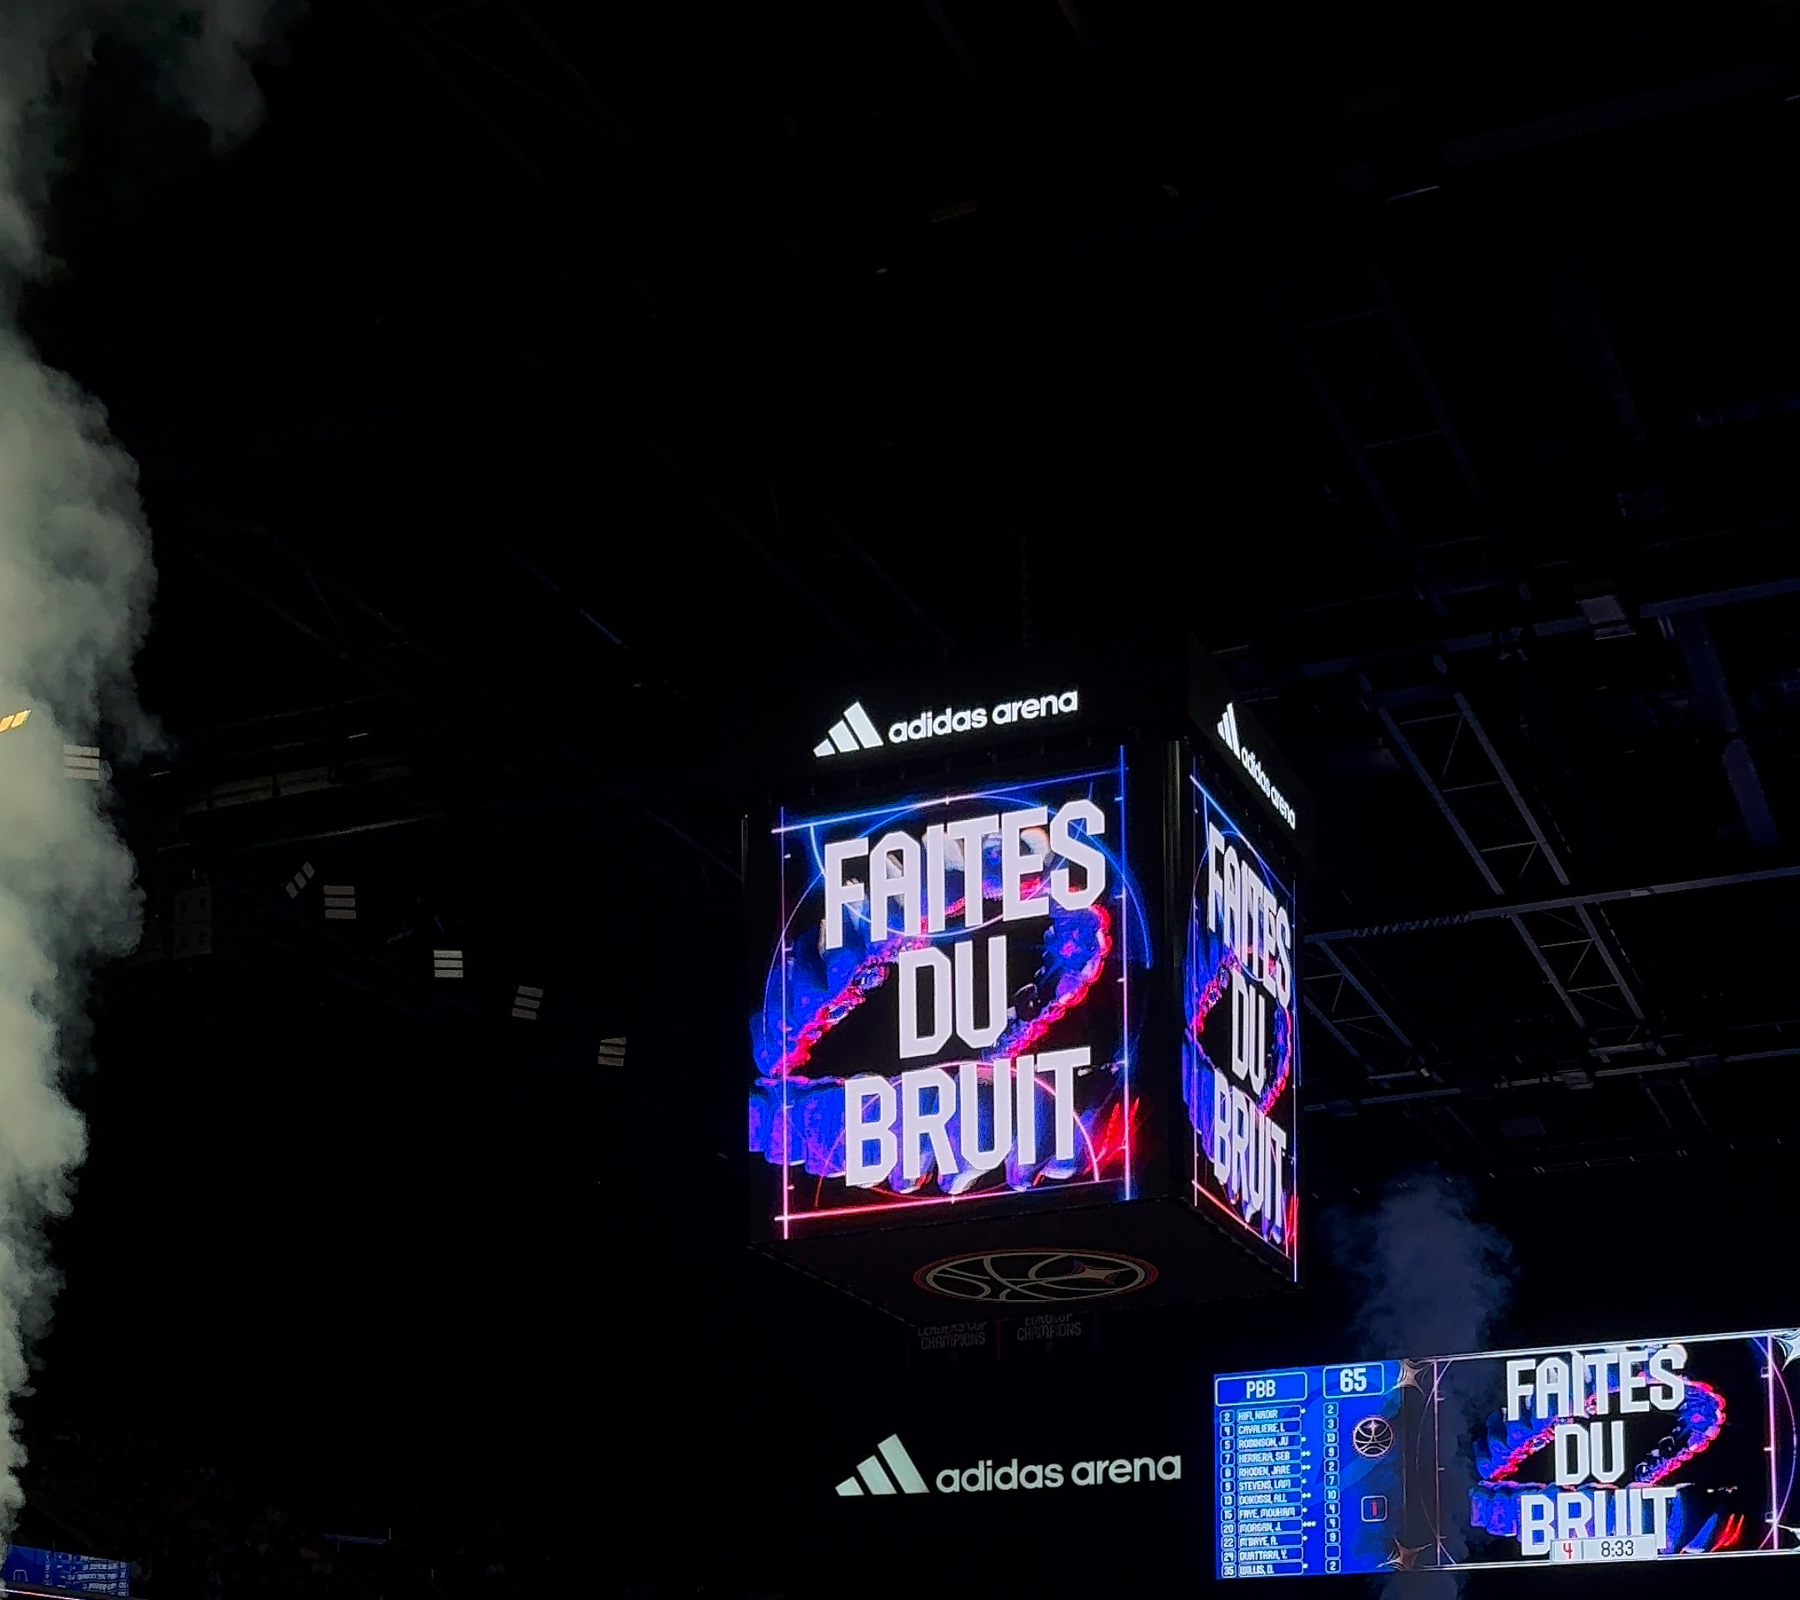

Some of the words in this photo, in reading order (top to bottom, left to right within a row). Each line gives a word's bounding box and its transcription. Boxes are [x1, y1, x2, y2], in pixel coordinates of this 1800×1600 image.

[887, 706, 988, 744] adidas
[992, 689, 1078, 725] arena
[1240, 746, 1271, 799] adidas
[1270, 785, 1296, 830] arena
[824, 799, 1106, 950] FAITES
[1207, 821, 1292, 1010] FAITES
[898, 934, 1008, 1059] DU
[1232, 966, 1266, 1094] DU
[844, 1046, 1092, 1188] BRUIT
[1212, 1067, 1288, 1230] BRUIT
[920, 1331, 986, 1351] CHAMPIONS
[1017, 1321, 1082, 1342] CHAMPIONS
[1245, 1379, 1277, 1399] PBB
[1340, 1367, 1368, 1393] 65
[1504, 1346, 1687, 1422] FAITES
[1224, 1412, 1231, 1422] 2
[1328, 1404, 1334, 1414] 2
[1328, 1418, 1334, 1428] 3
[1224, 1440, 1231, 1450] 5
[1554, 1420, 1626, 1487] DU
[1224, 1454, 1231, 1464] 7
[1328, 1461, 1334, 1471] 2
[935, 1458, 1065, 1494] adidas
[1070, 1455, 1182, 1486] arena
[1329, 1475, 1335, 1486] 7
[1223, 1524, 1234, 1533] 20
[1520, 1486, 1678, 1557] BRUIT
[1223, 1538, 1234, 1548] 22
[1563, 1542, 1573, 1560] 4
[1601, 1540, 1634, 1558] 8:33
[1329, 1561, 1336, 1571] 2
